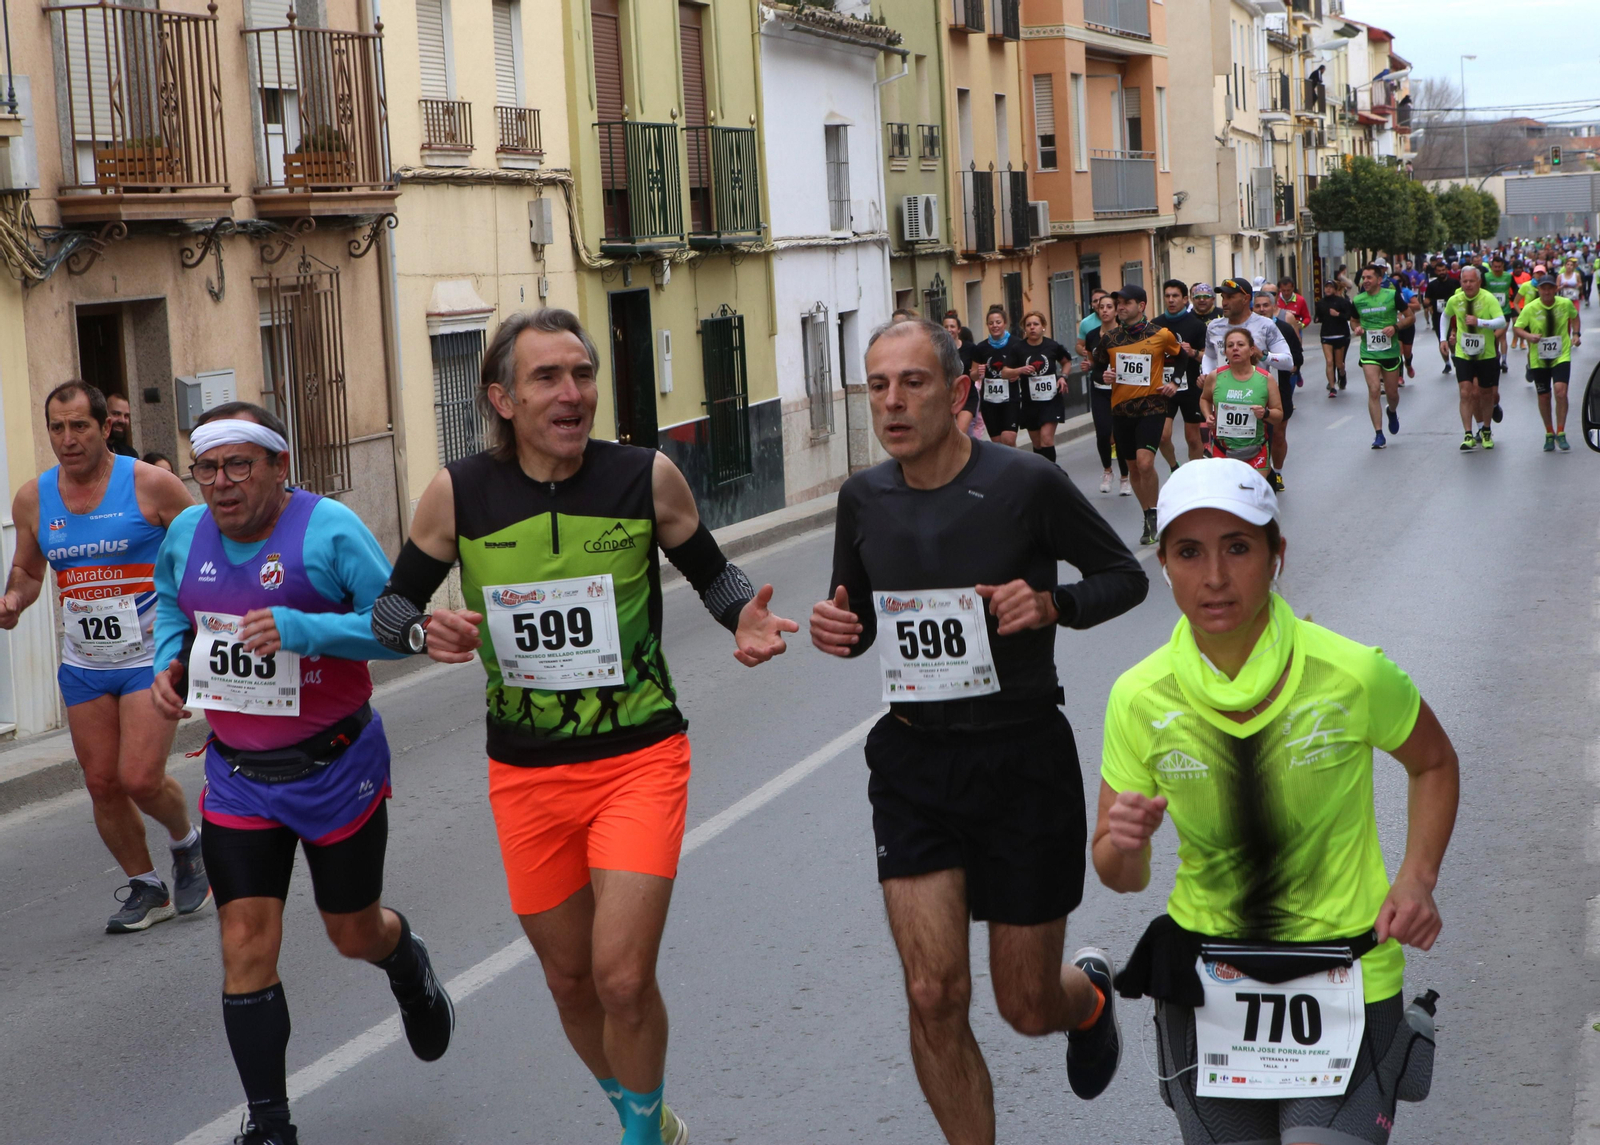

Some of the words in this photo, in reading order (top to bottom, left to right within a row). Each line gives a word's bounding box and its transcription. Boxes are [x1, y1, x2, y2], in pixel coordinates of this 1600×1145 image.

[1371, 335, 1387, 344] 266
[1465, 338, 1480, 348] 870
[1542, 342, 1557, 351] 732
[1123, 361, 1144, 374] 766
[988, 385, 1004, 394] 844
[1034, 381, 1052, 392] 496
[1226, 412, 1250, 426] 907
[47, 539, 129, 561] enerplus
[66, 566, 123, 584] Maratón
[78, 615, 122, 640] 126
[512, 606, 594, 652] 599
[896, 618, 967, 660] 598
[209, 639, 277, 679] 563
[575, 648, 601, 656] ROMERO
[1235, 992, 1322, 1046] 770
